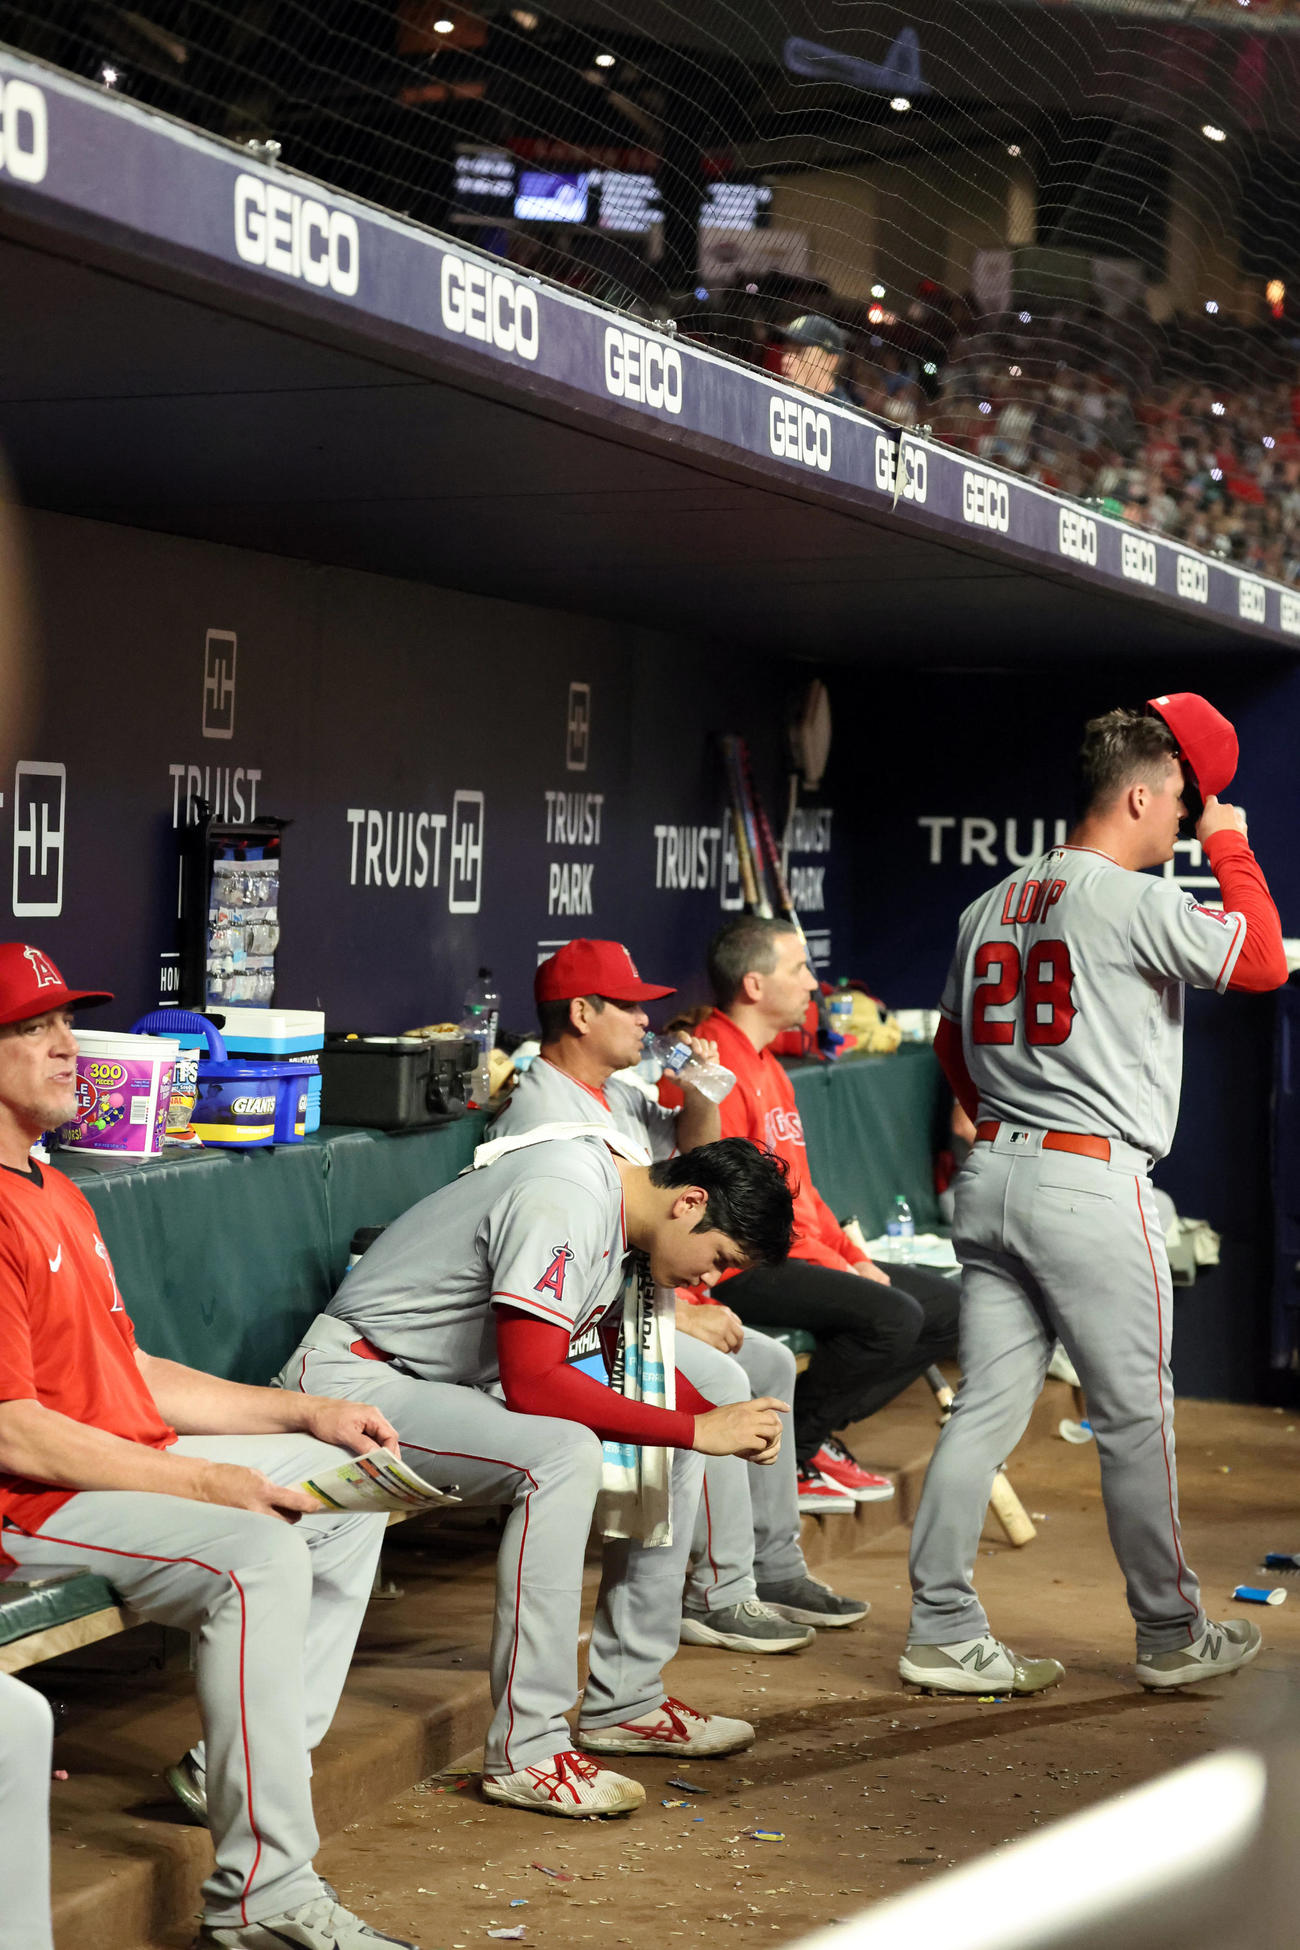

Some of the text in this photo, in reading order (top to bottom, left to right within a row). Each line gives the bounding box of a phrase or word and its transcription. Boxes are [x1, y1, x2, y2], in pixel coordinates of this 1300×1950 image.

[234, 174, 359, 296] GEICO
[441, 254, 539, 361] GEICO
[604, 326, 683, 414] GEICO
[769, 395, 832, 472] GEICO
[874, 434, 927, 503] GECO
[963, 471, 1009, 533] GEICO
[1059, 508, 1097, 566] GEICO
[1121, 533, 1156, 586] GEICO
[1177, 554, 1208, 603] GEICO
[169, 764, 262, 829] TRUIST
[546, 791, 604, 845] TRUIST
[347, 809, 447, 888] TRUIST
[654, 824, 721, 890] TRUIST
[549, 863, 595, 916] PARK
[973, 940, 1079, 1047] 28
[90, 1063, 122, 1080] 300
[231, 1096, 276, 1115] GIANTS
[533, 1241, 575, 1301] A
